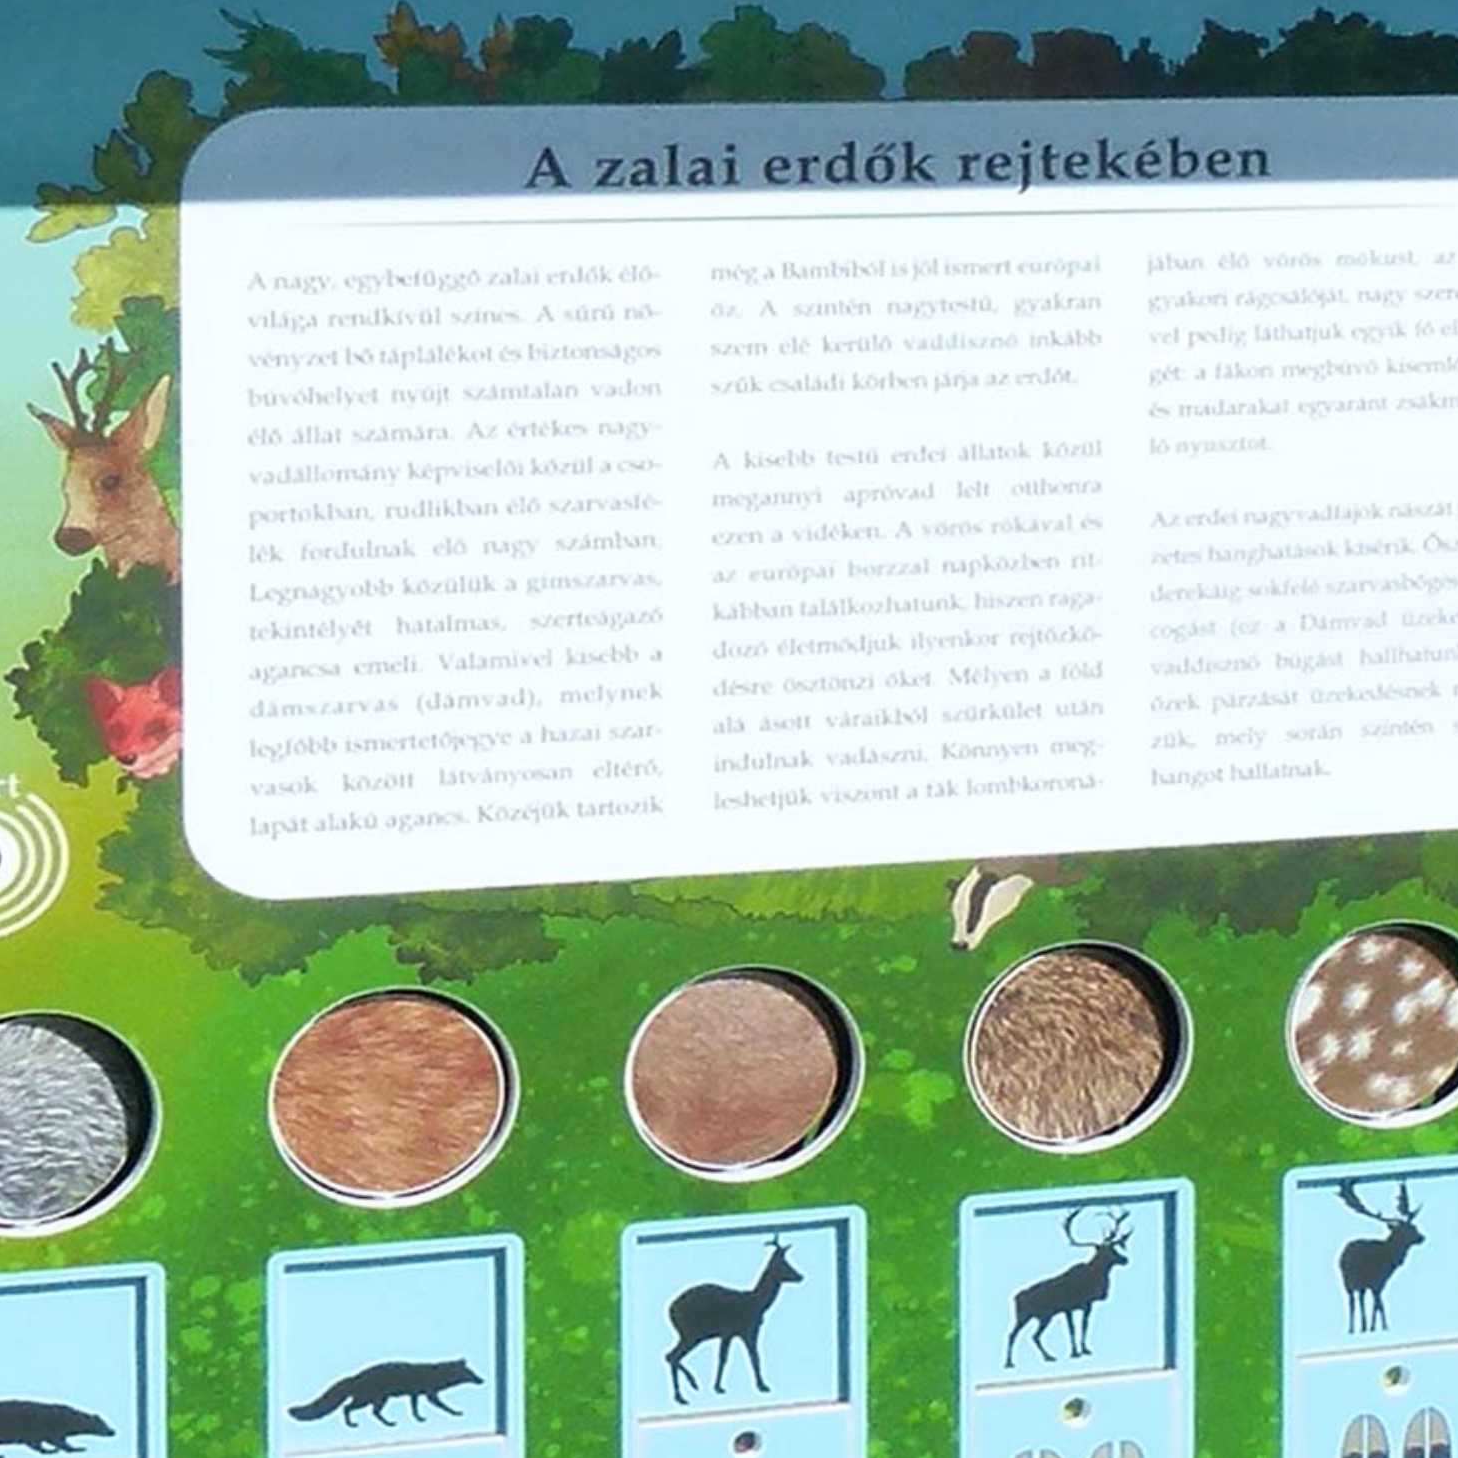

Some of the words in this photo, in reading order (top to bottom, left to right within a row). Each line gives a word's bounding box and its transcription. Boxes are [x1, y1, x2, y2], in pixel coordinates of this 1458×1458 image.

[523, 145, 573, 189] A
[594, 141, 741, 188] zalai
[762, 140, 937, 185] erdők
[957, 135, 1271, 196] rejtekében
[246, 268, 267, 293] A
[535, 298, 555, 323] A
[598, 457, 612, 475] a
[503, 576, 518, 594] a
[649, 644, 664, 662] a
[519, 728, 533, 746] a
